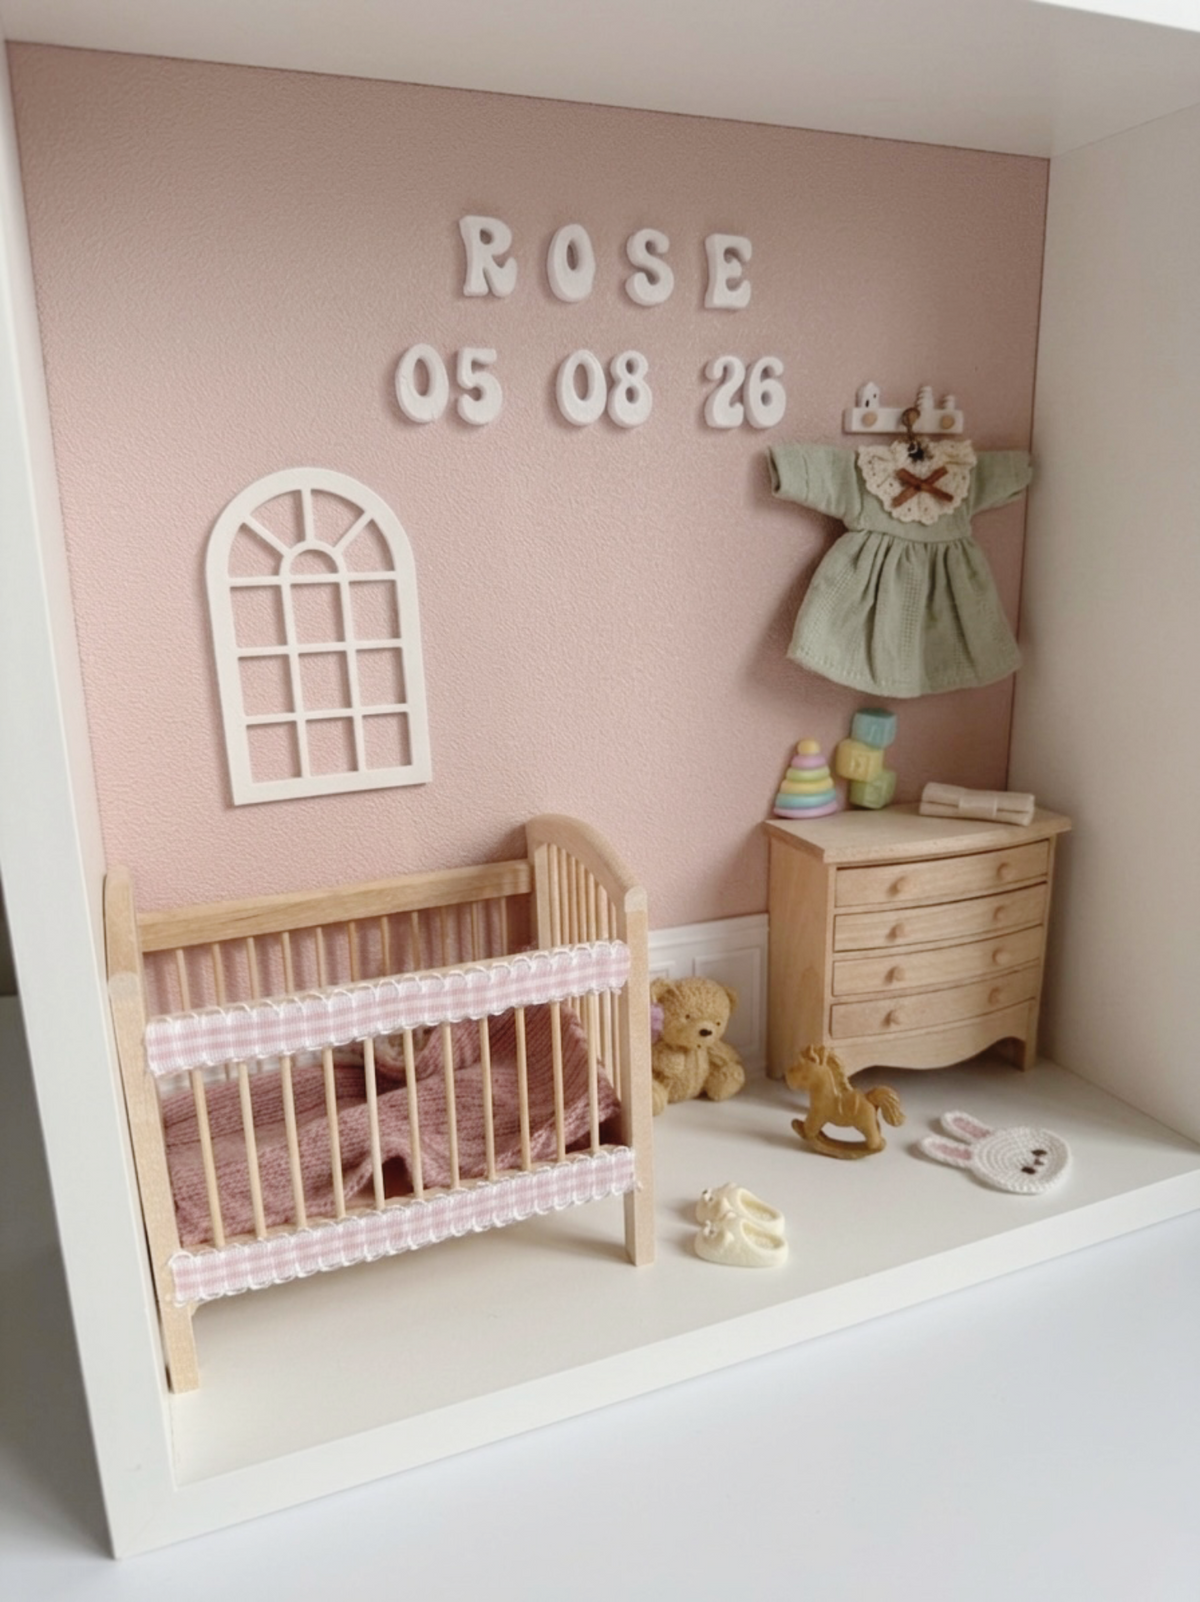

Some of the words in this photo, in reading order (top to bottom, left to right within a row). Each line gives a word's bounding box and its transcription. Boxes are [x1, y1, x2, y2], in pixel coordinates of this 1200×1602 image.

[459, 215, 753, 309] ROSE
[395, 343, 503, 425] 05
[556, 349, 653, 428] 08
[704, 355, 786, 429] 26
